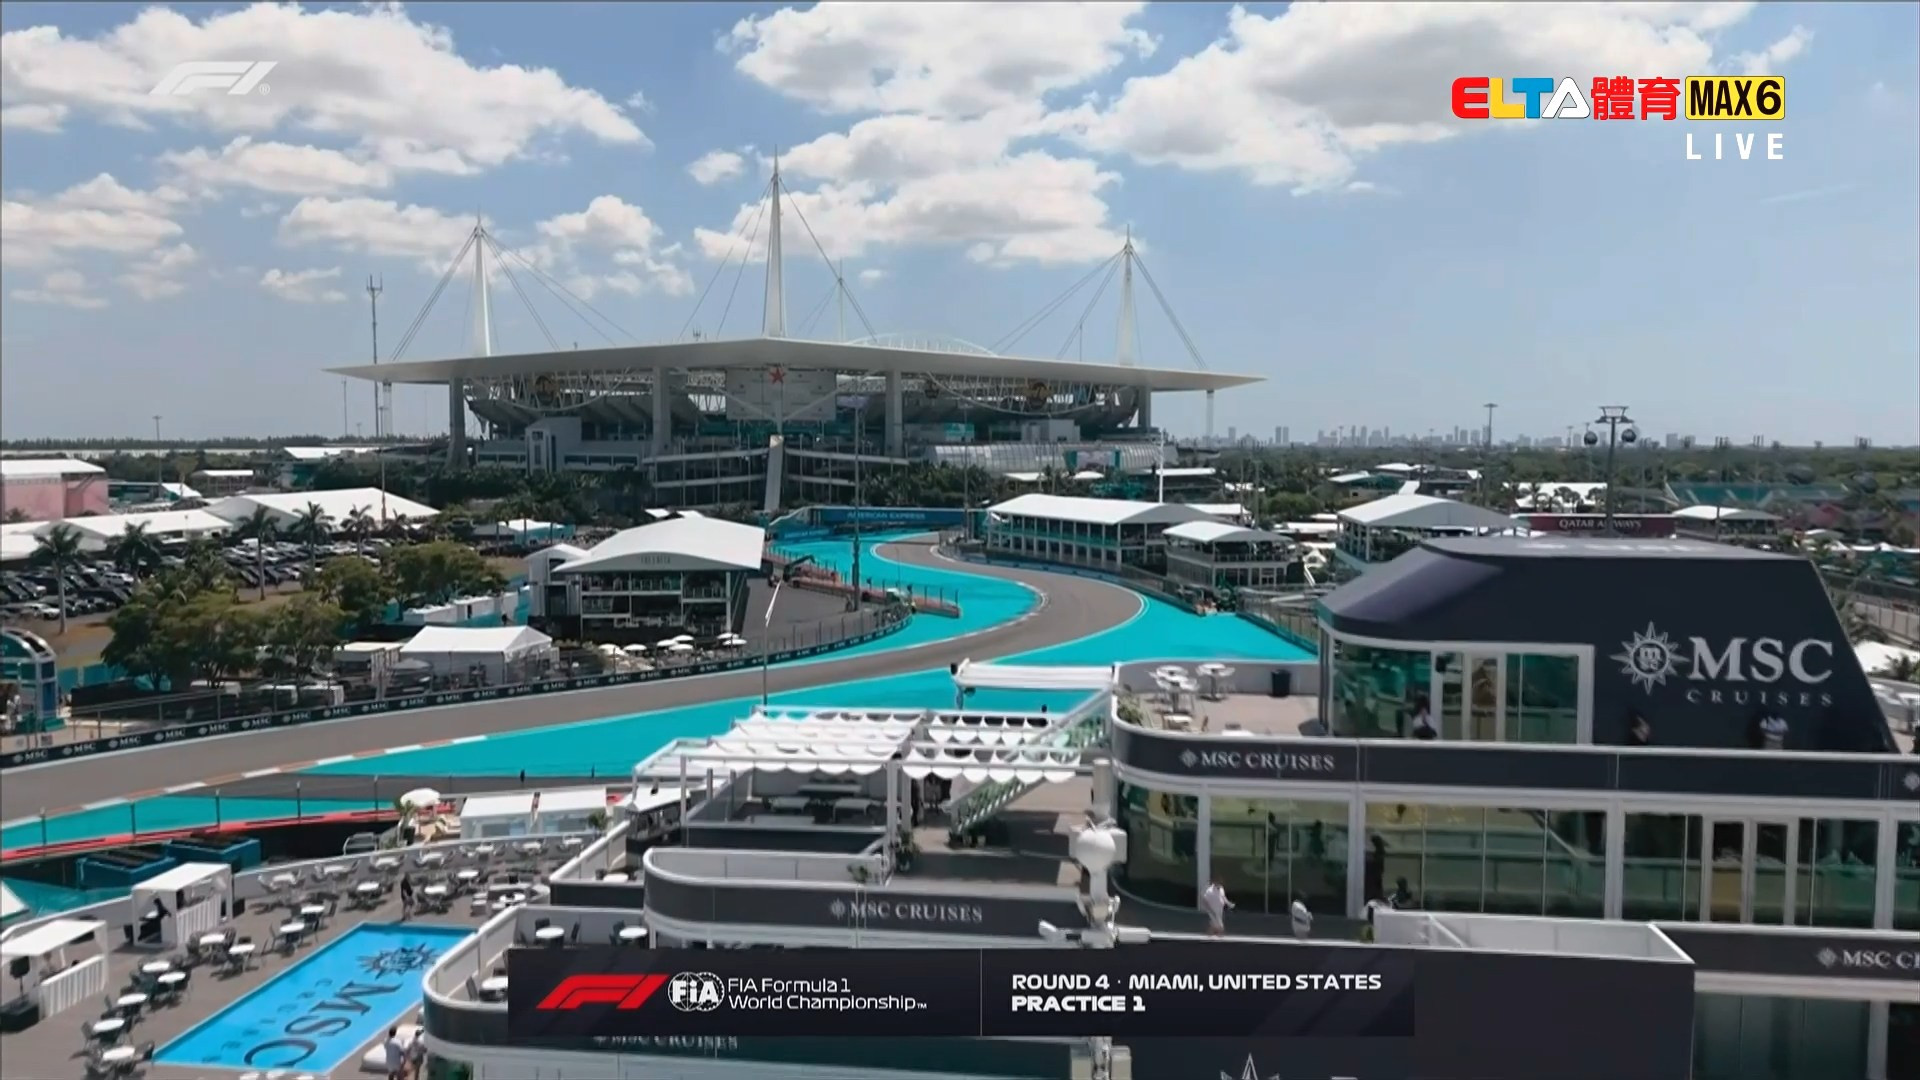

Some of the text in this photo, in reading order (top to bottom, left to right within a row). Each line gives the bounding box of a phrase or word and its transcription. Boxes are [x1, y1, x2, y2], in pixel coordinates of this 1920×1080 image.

[1559, 519, 1594, 529] QATAR
[1687, 635, 1834, 684] MSC
[1686, 689, 1834, 706] CRUISES
[209, 722, 230, 733] MSC
[251, 718, 272, 727] MSC
[164, 729, 187, 740] MSC
[119, 736, 142, 747] MSC
[74, 743, 97, 754] MSC
[25, 751, 48, 761] MSC
[1201, 751, 1335, 771] MSC CRUISES
[850, 901, 983, 922] MSC CRUISES
[1842, 950, 1891, 969] MSC
[244, 980, 404, 1067] MSC
